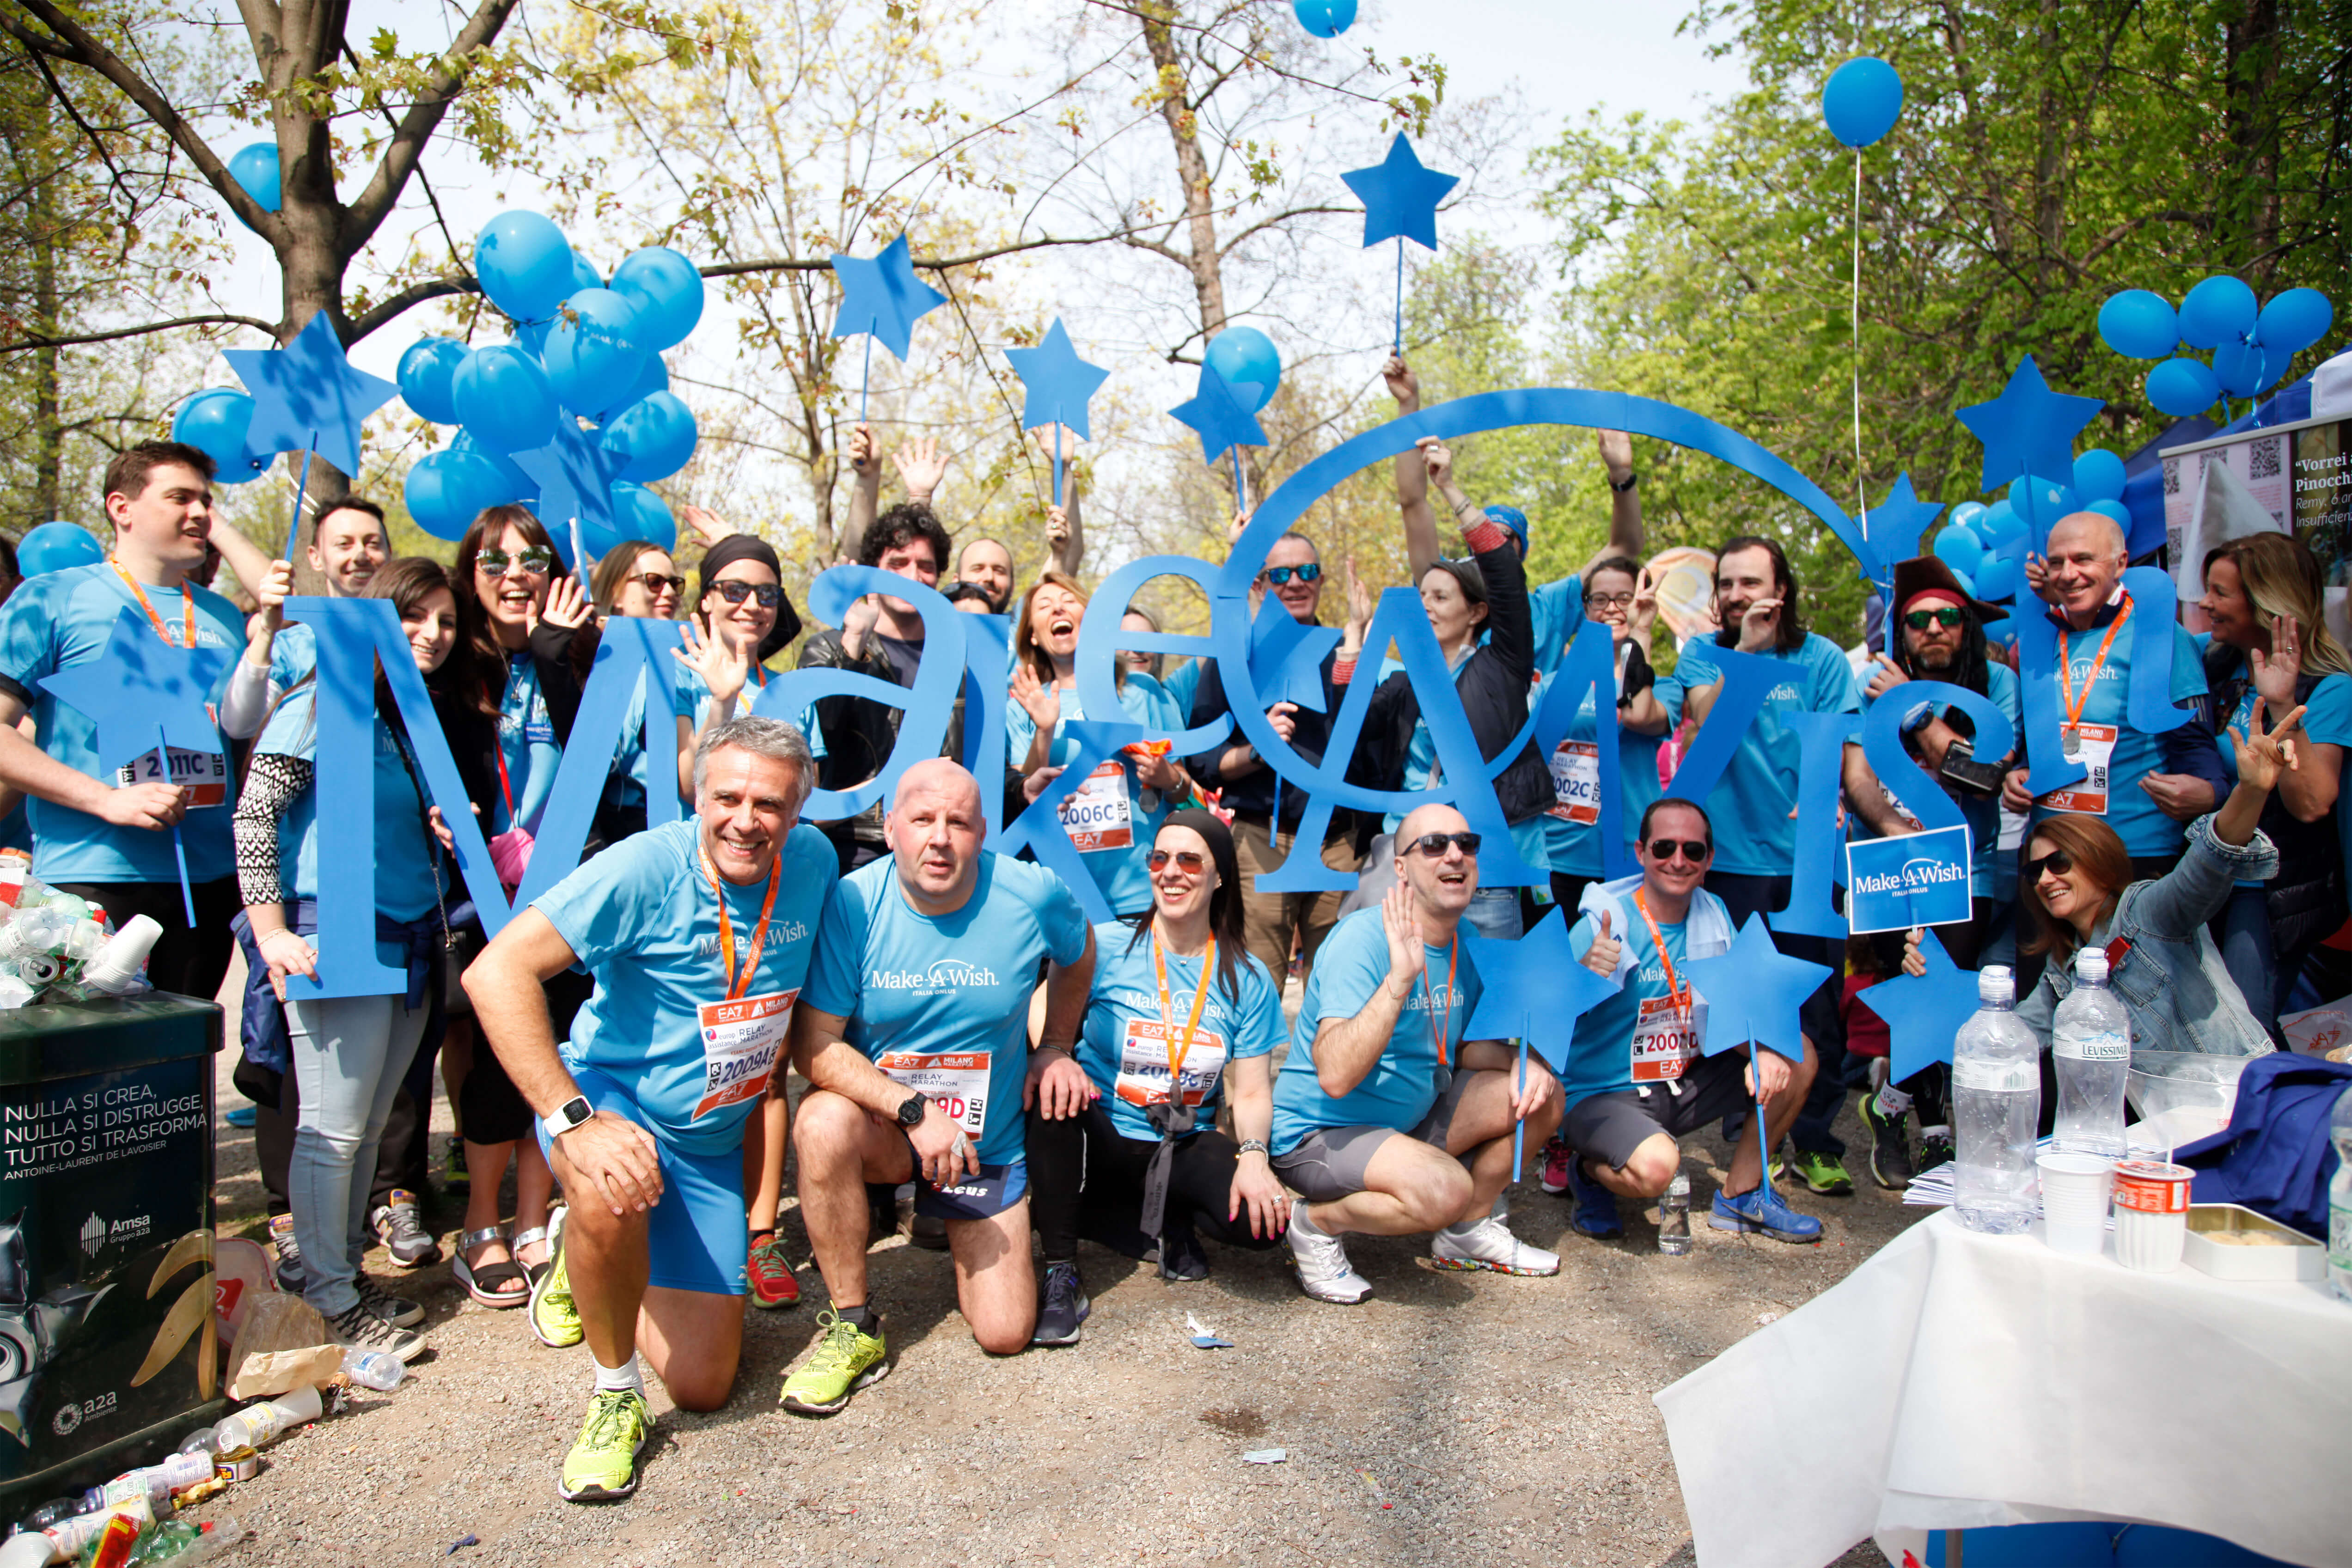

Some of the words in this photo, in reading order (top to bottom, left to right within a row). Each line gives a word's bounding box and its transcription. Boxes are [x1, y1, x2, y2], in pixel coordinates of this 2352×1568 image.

[2331, 493, 2338, 505] 6
[1553, 777, 1590, 798] 002C
[1074, 832, 1103, 846] EA7
[1892, 889, 1908, 897] ITALIA
[765, 997, 789, 1008] MILANO
[718, 1005, 743, 1020] EA7
[719, 1031, 736, 1040] europ
[739, 1024, 766, 1037] RELAY
[739, 1028, 774, 1044] MARATHON
[1142, 1024, 1165, 1036] EA7
[708, 1039, 737, 1050] assistance
[2083, 1044, 2128, 1056] LEVISSIMA
[1125, 1049, 1153, 1057] assistance
[720, 1046, 770, 1084] 2009A
[894, 1056, 920, 1067] EA7
[718, 1080, 750, 1101] EA7
[5, 1097, 78, 1123] NULLA
[83, 1092, 98, 1109] SI
[104, 1084, 156, 1105] CREA,
[5, 1118, 78, 1145] NULLA
[83, 1114, 98, 1131] SI
[104, 1094, 203, 1127] DISTRUGGE,
[5, 1140, 75, 1166] TUTTO
[80, 1135, 96, 1153] SI
[103, 1112, 208, 1147] TRASFORMA
[3, 1153, 104, 1181] ANTOINE-LAURENT
[106, 1150, 119, 1160] DE
[121, 1140, 167, 1157] LAVOISIER
[110, 1214, 151, 1234] Amsa
[110, 1232, 135, 1244] Gruppo
[135, 1226, 151, 1237] a2a
[84, 1391, 117, 1415] a2a
[84, 1405, 118, 1423] Ambiente
